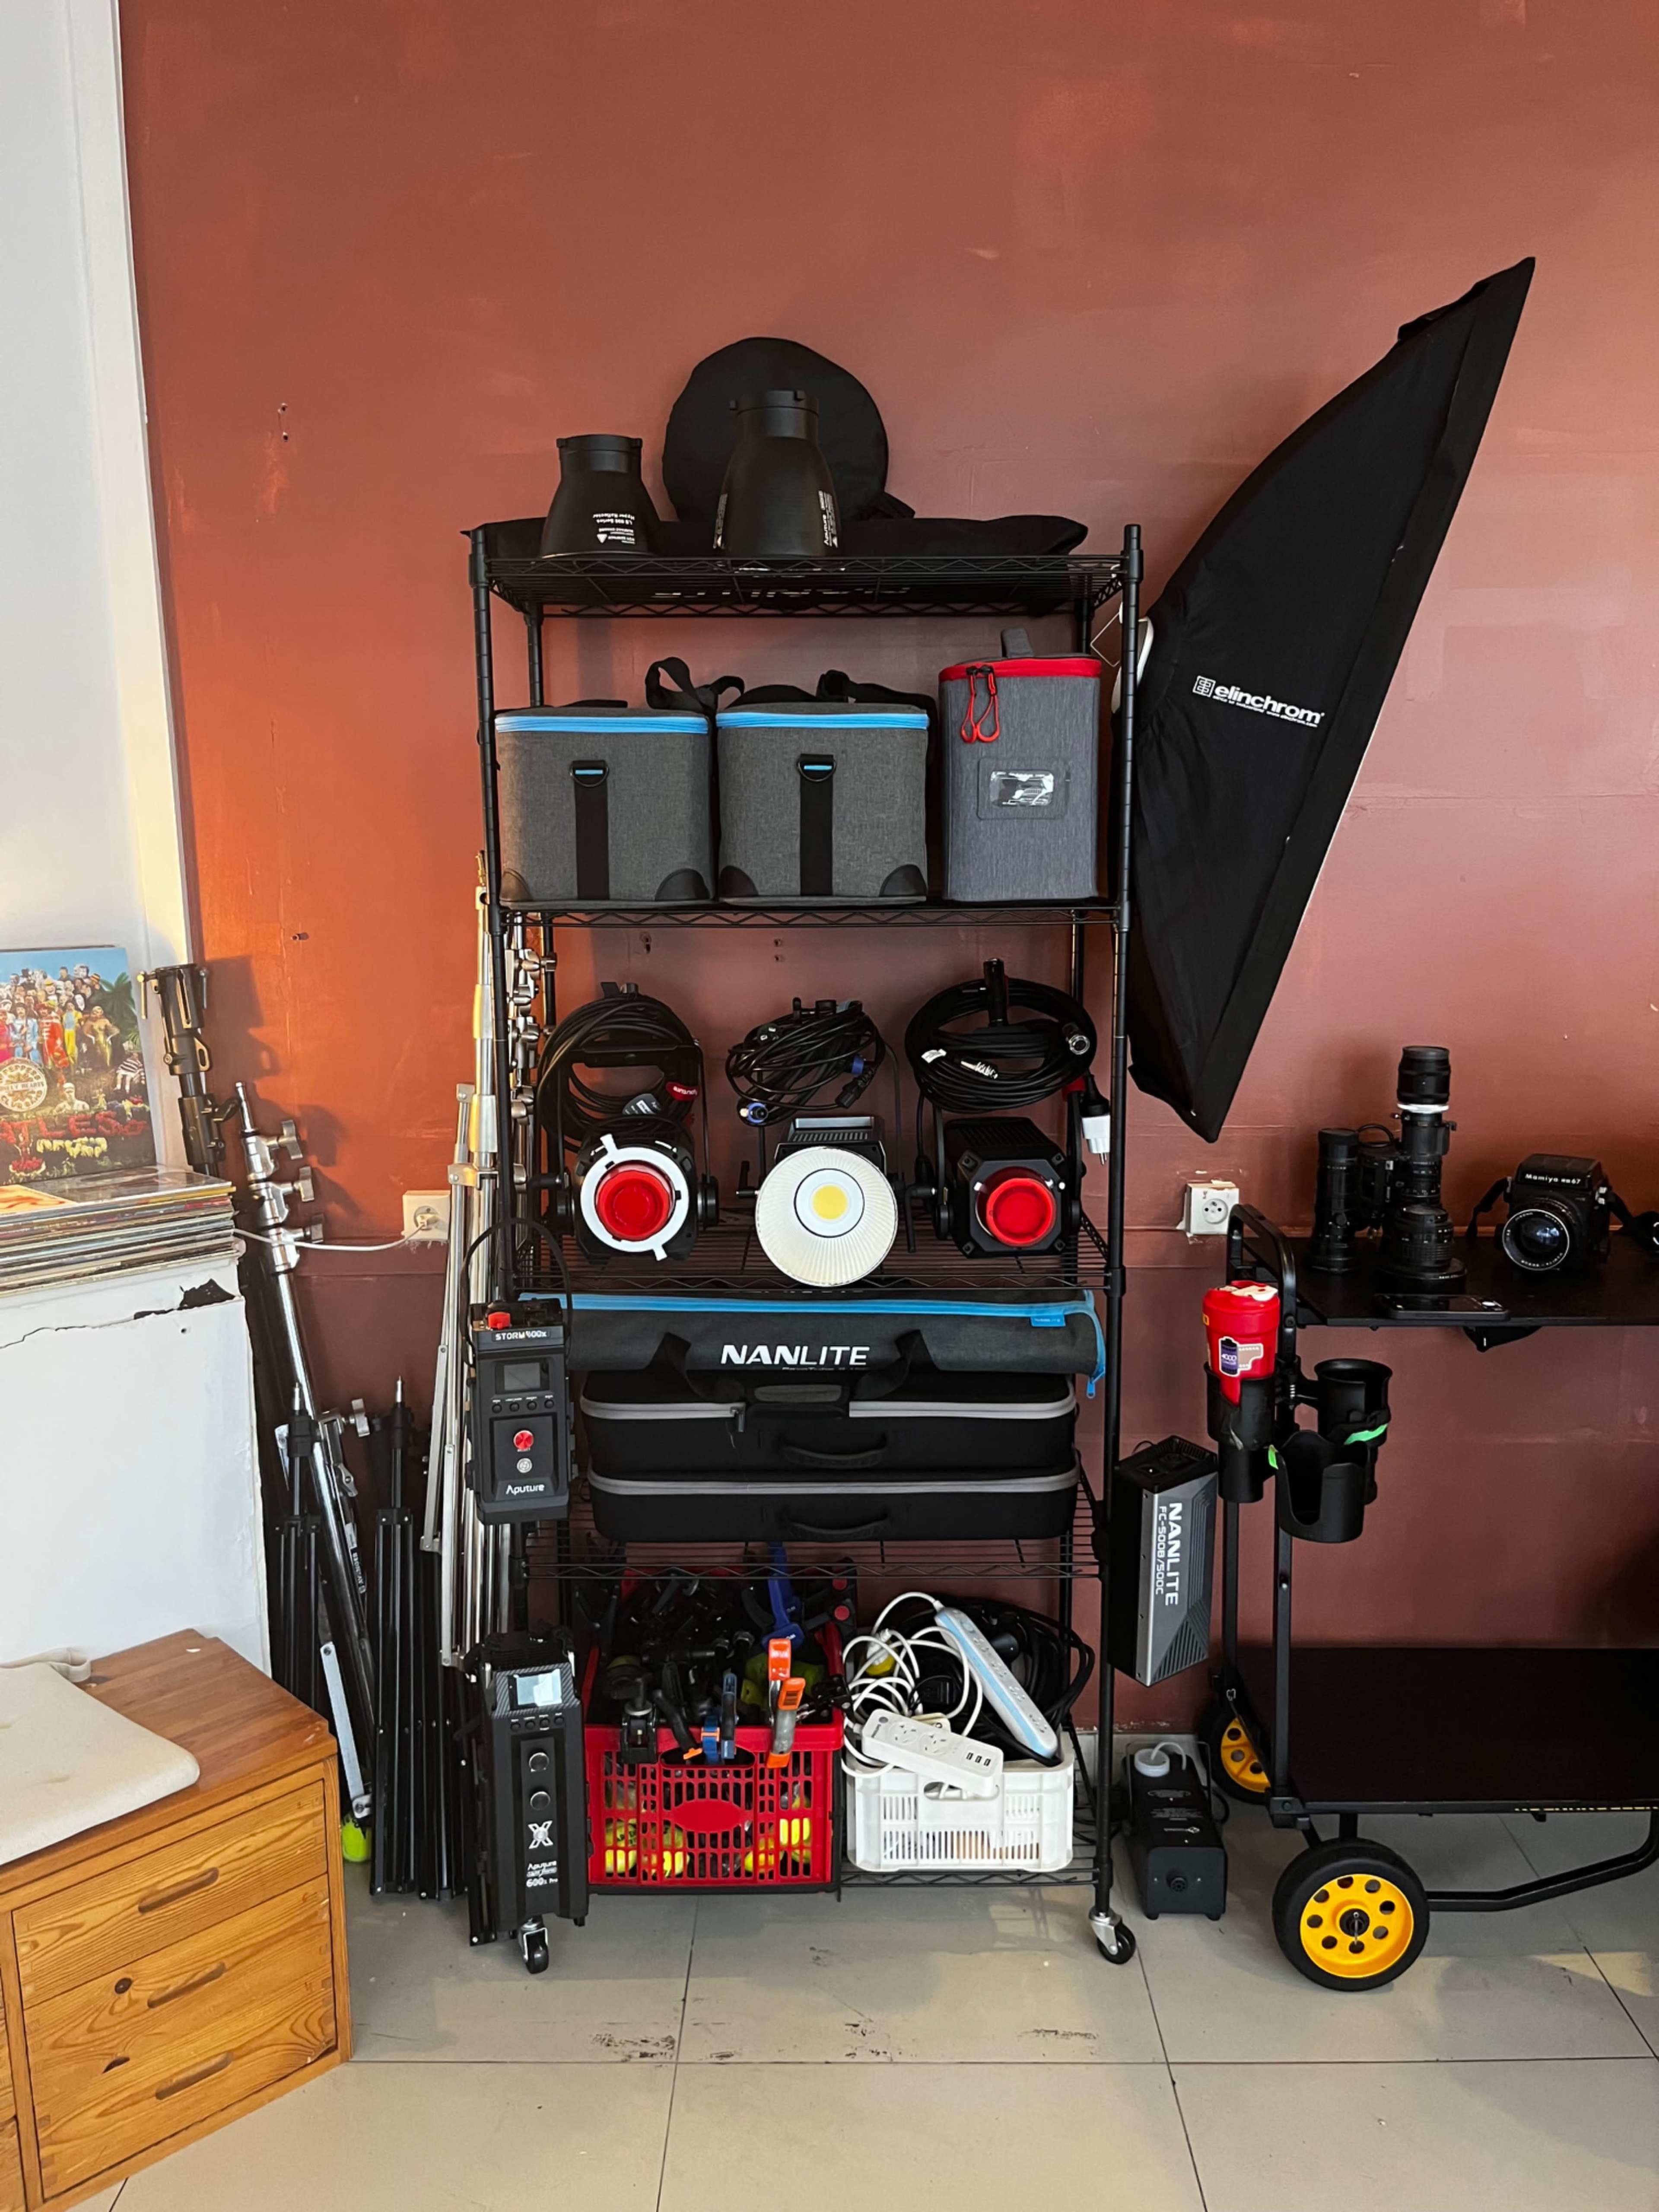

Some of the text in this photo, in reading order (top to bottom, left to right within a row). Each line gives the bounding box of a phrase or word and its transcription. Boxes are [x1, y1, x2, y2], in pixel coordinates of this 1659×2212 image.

[1214, 685, 1320, 724] elinchrom
[1525, 1173, 1558, 1183] Mamiya
[721, 1344, 870, 1366] NANLITE
[505, 1484, 545, 1495] Aputure
[1156, 1506, 1166, 1595] FC-500B/500C
[1165, 1502, 1183, 1606] NANLITE
